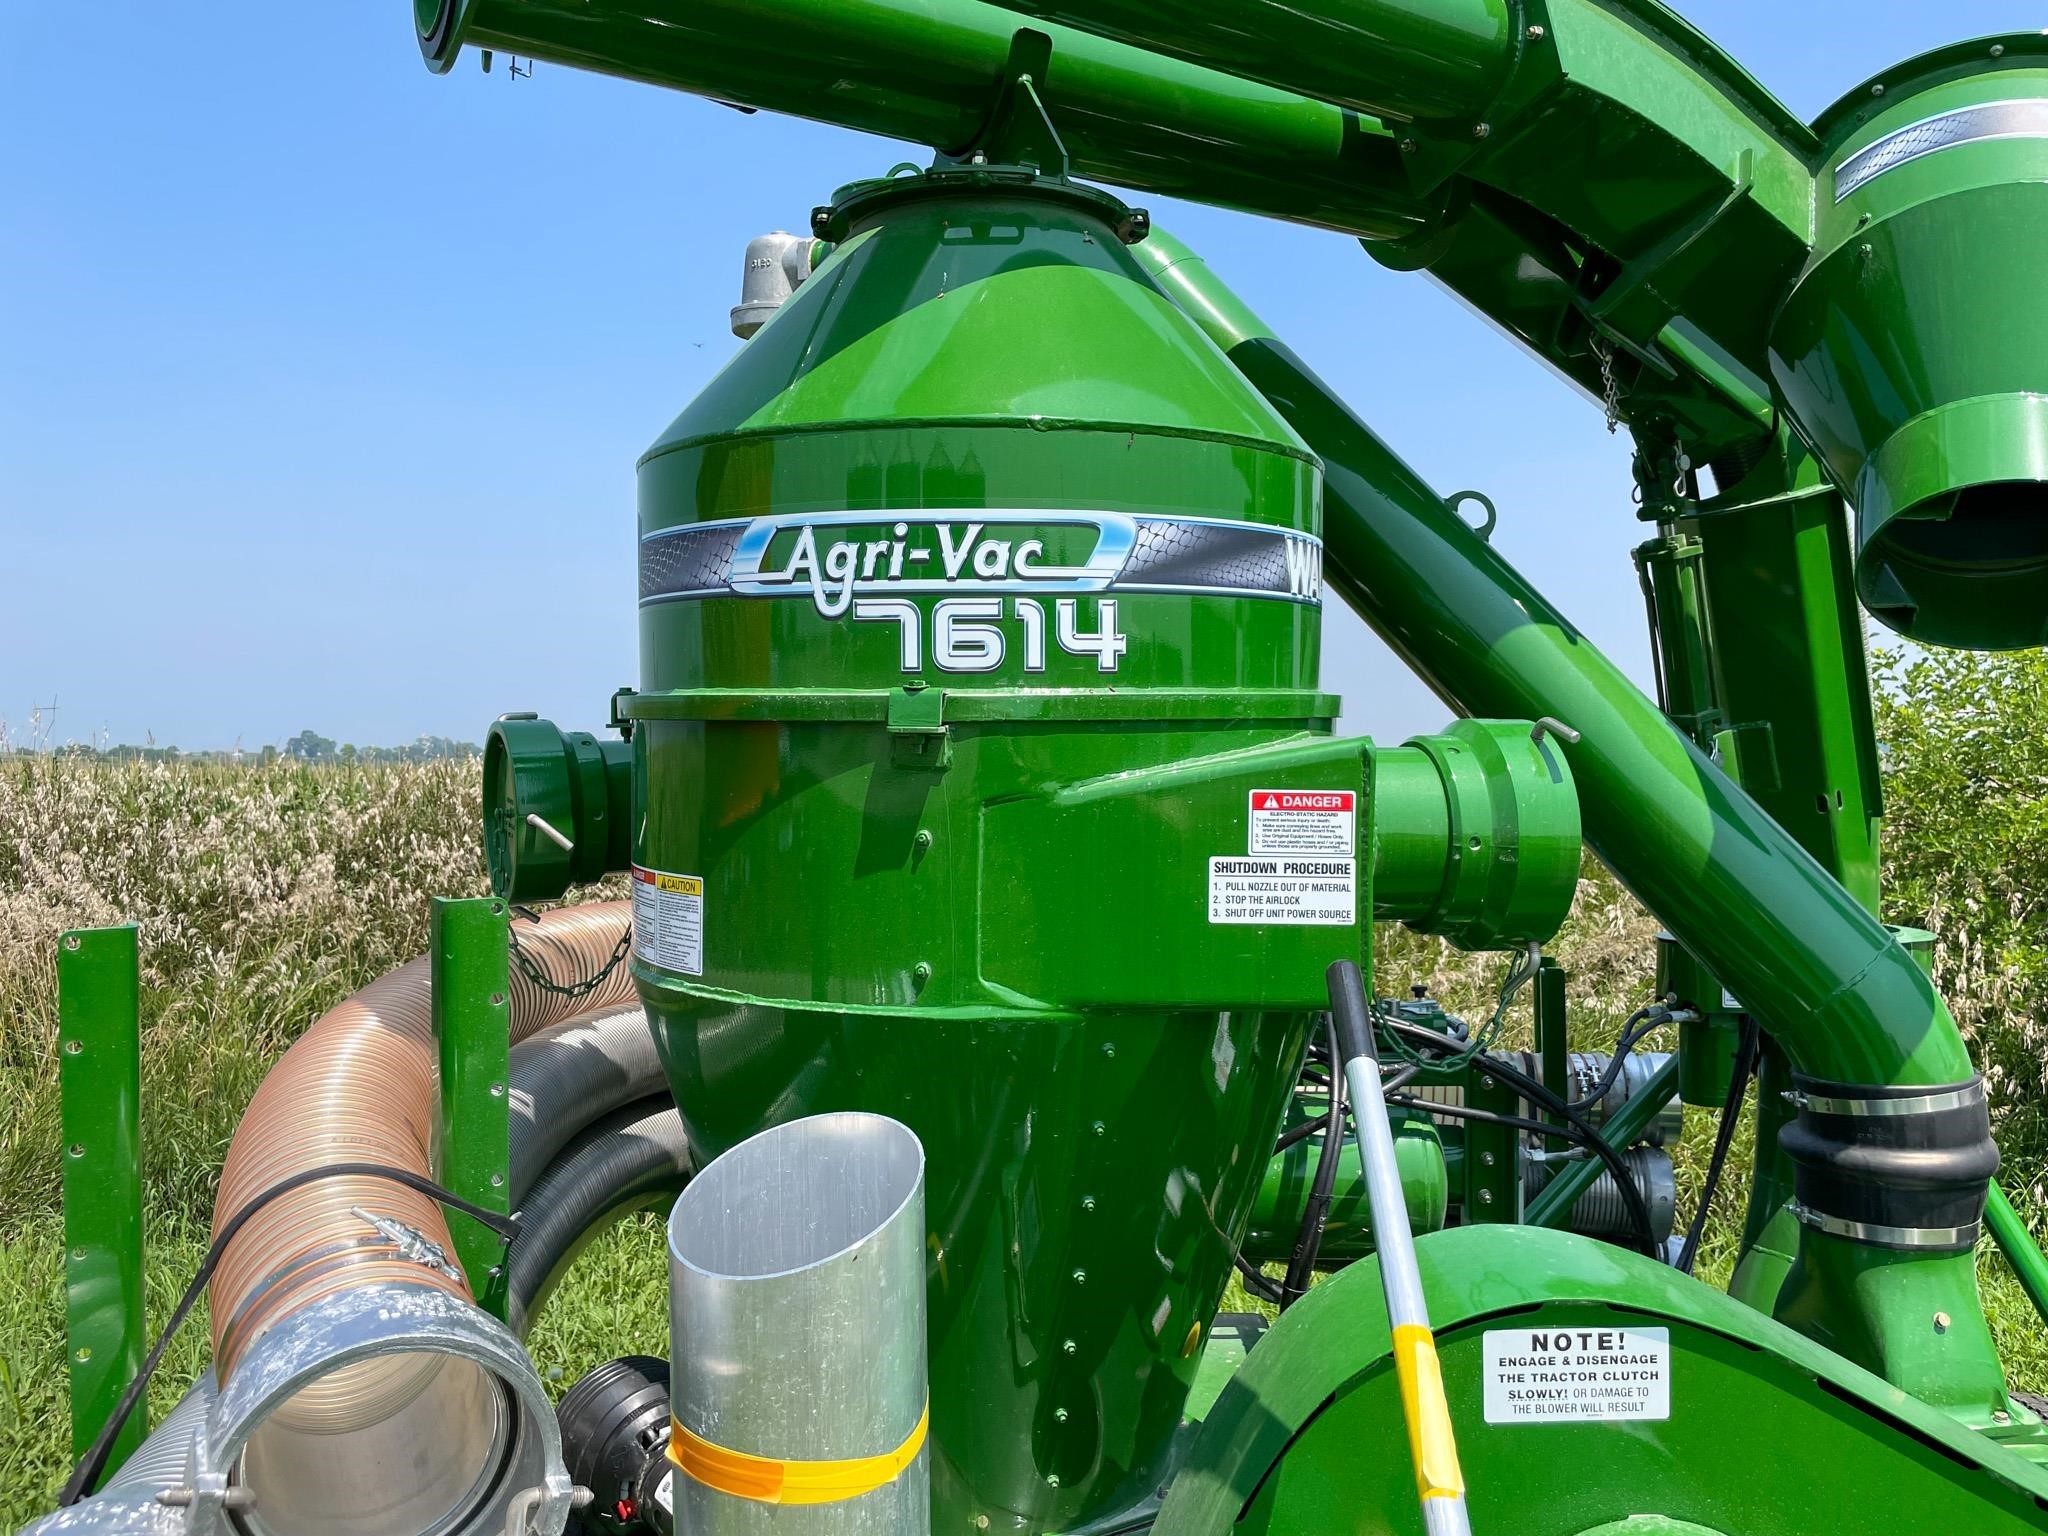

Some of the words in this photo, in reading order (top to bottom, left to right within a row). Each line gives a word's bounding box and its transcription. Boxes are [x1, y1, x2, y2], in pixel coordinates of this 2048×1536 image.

[764, 520, 1056, 618] Agri-Vac
[853, 598, 1126, 672] 7614
[1283, 796, 1342, 807] DANGER
[1214, 862, 1277, 874] SHUTDOWN
[1284, 863, 1350, 874] PROCEDURE
[667, 878, 695, 892] CAUTION
[1213, 882, 1221, 891] 1.
[1226, 882, 1245, 891] PULL
[1248, 883, 1278, 891] NOZZLE
[1280, 883, 1297, 892] OUT
[1299, 883, 1309, 892] OF
[1312, 883, 1351, 892] MATERIAL
[1213, 896, 1221, 904] 2.
[1225, 896, 1246, 904] STOP
[1249, 896, 1264, 904] THE
[1266, 896, 1300, 905] AIRLOCK
[1213, 909, 1220, 917] 3.
[1225, 909, 1246, 917] SHUT
[1249, 909, 1264, 917] OFF
[1267, 909, 1285, 918] UNIT
[1287, 909, 1316, 918] POWER
[1319, 910, 1351, 919] SOURCE
[1532, 1332, 1625, 1351] NOTE!
[1499, 1356, 1556, 1367] ENGAGE
[1562, 1356, 1571, 1366] &
[1577, 1354, 1658, 1365] DISENGAGE
[1498, 1373, 1525, 1383] THE
[1531, 1372, 1597, 1383] TRACTOR
[1603, 1371, 1659, 1381] CLUTCH
[1508, 1389, 1568, 1399] SLOWLY!
[1573, 1388, 1587, 1398] OR
[1591, 1387, 1633, 1398] DAMAGE
[1636, 1387, 1649, 1397] TO
[1512, 1405, 1531, 1414] THE
[1535, 1403, 1577, 1413] BLOWER
[1580, 1402, 1604, 1413] WILL
[1608, 1401, 1645, 1412] RESULT
